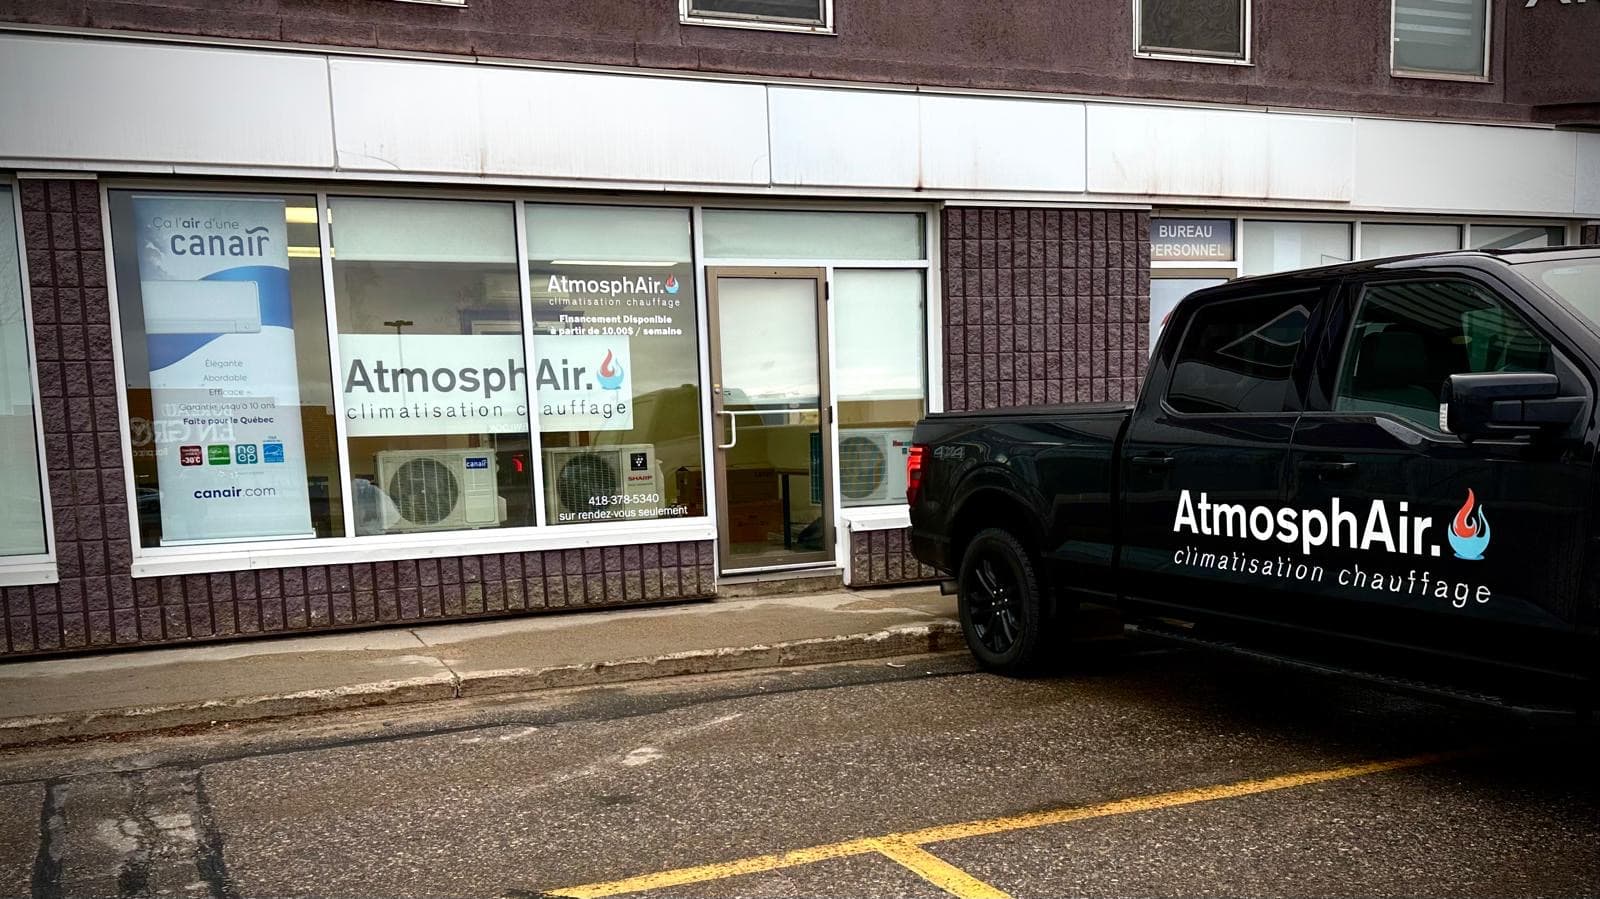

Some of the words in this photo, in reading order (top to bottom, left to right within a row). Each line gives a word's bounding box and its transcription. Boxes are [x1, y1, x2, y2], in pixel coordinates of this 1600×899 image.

[152, 216, 172, 231] Ça
[175, 217, 200, 229] l'air
[203, 217, 239, 230] d'une
[1159, 225, 1213, 238] BUREAU
[547, 275, 664, 297] AtmosphAir.
[548, 297, 622, 306] climatisation
[626, 297, 681, 309] chauffage
[559, 314, 621, 324] Financement
[623, 315, 673, 325] Disponible
[558, 326, 586, 337] partir
[587, 326, 600, 335] de
[602, 326, 634, 336] 10.00$
[643, 326, 683, 336] semaine
[203, 374, 248, 382] Abordable
[208, 388, 244, 396] Efficace
[179, 402, 217, 412] Garantie
[249, 401, 259, 410] 10
[260, 402, 276, 410] ans
[346, 402, 503, 419] climatisation
[516, 400, 626, 419] cauffage
[183, 417, 206, 426] Faite
[207, 418, 229, 426] pour
[230, 416, 239, 424] le
[239, 415, 274, 425] Québec
[193, 486, 277, 500] canair.com
[588, 493, 660, 506] 418-378-5340
[559, 511, 576, 521] sur
[578, 508, 637, 520] rendez-vous
[638, 506, 689, 517] seulement
[1173, 489, 1441, 557] AtmosphAir.
[1173, 545, 1324, 583] climatisation
[1338, 564, 1492, 609] chauffage
